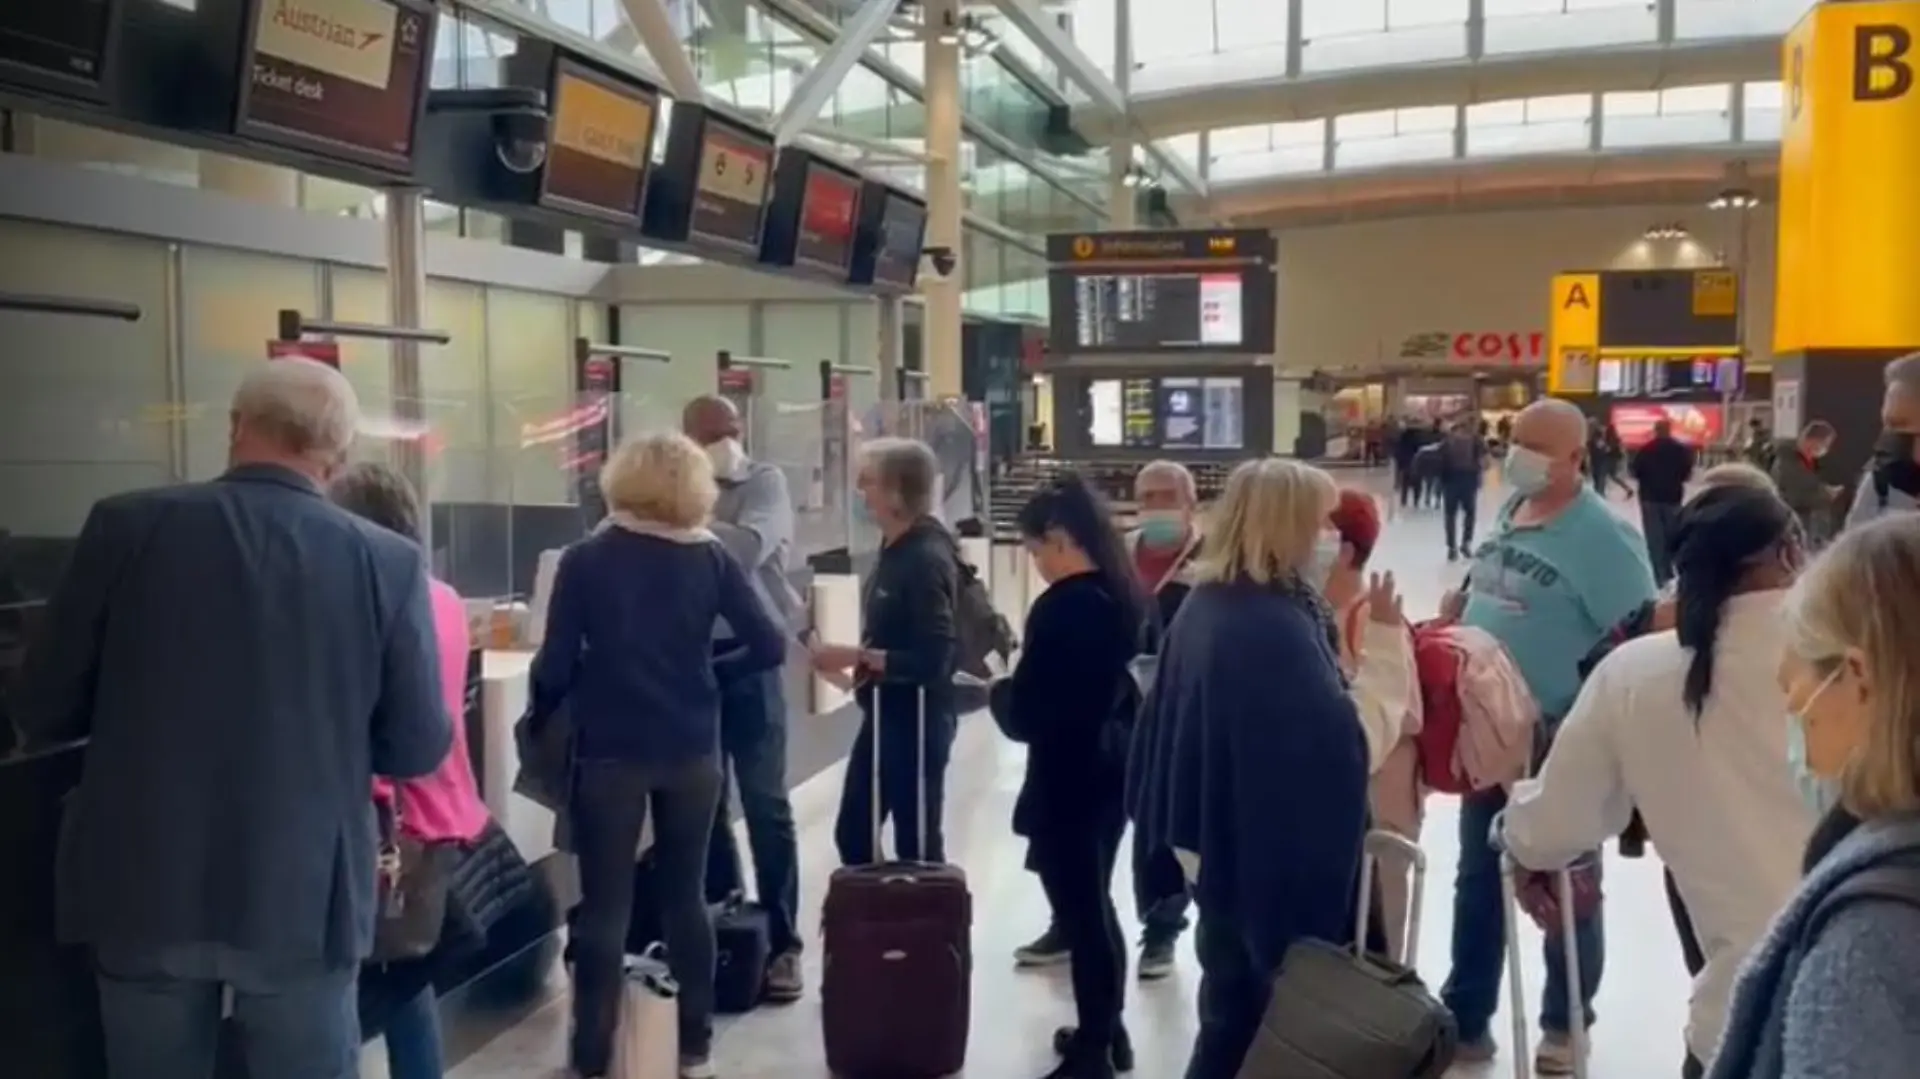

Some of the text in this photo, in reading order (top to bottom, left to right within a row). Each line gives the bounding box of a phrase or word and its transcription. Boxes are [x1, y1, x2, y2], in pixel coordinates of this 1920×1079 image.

[273, 0, 356, 48] Austrian
[253, 64, 324, 101] Ticket desk
[1853, 23, 1914, 102] B
[1563, 282, 1591, 309] A
